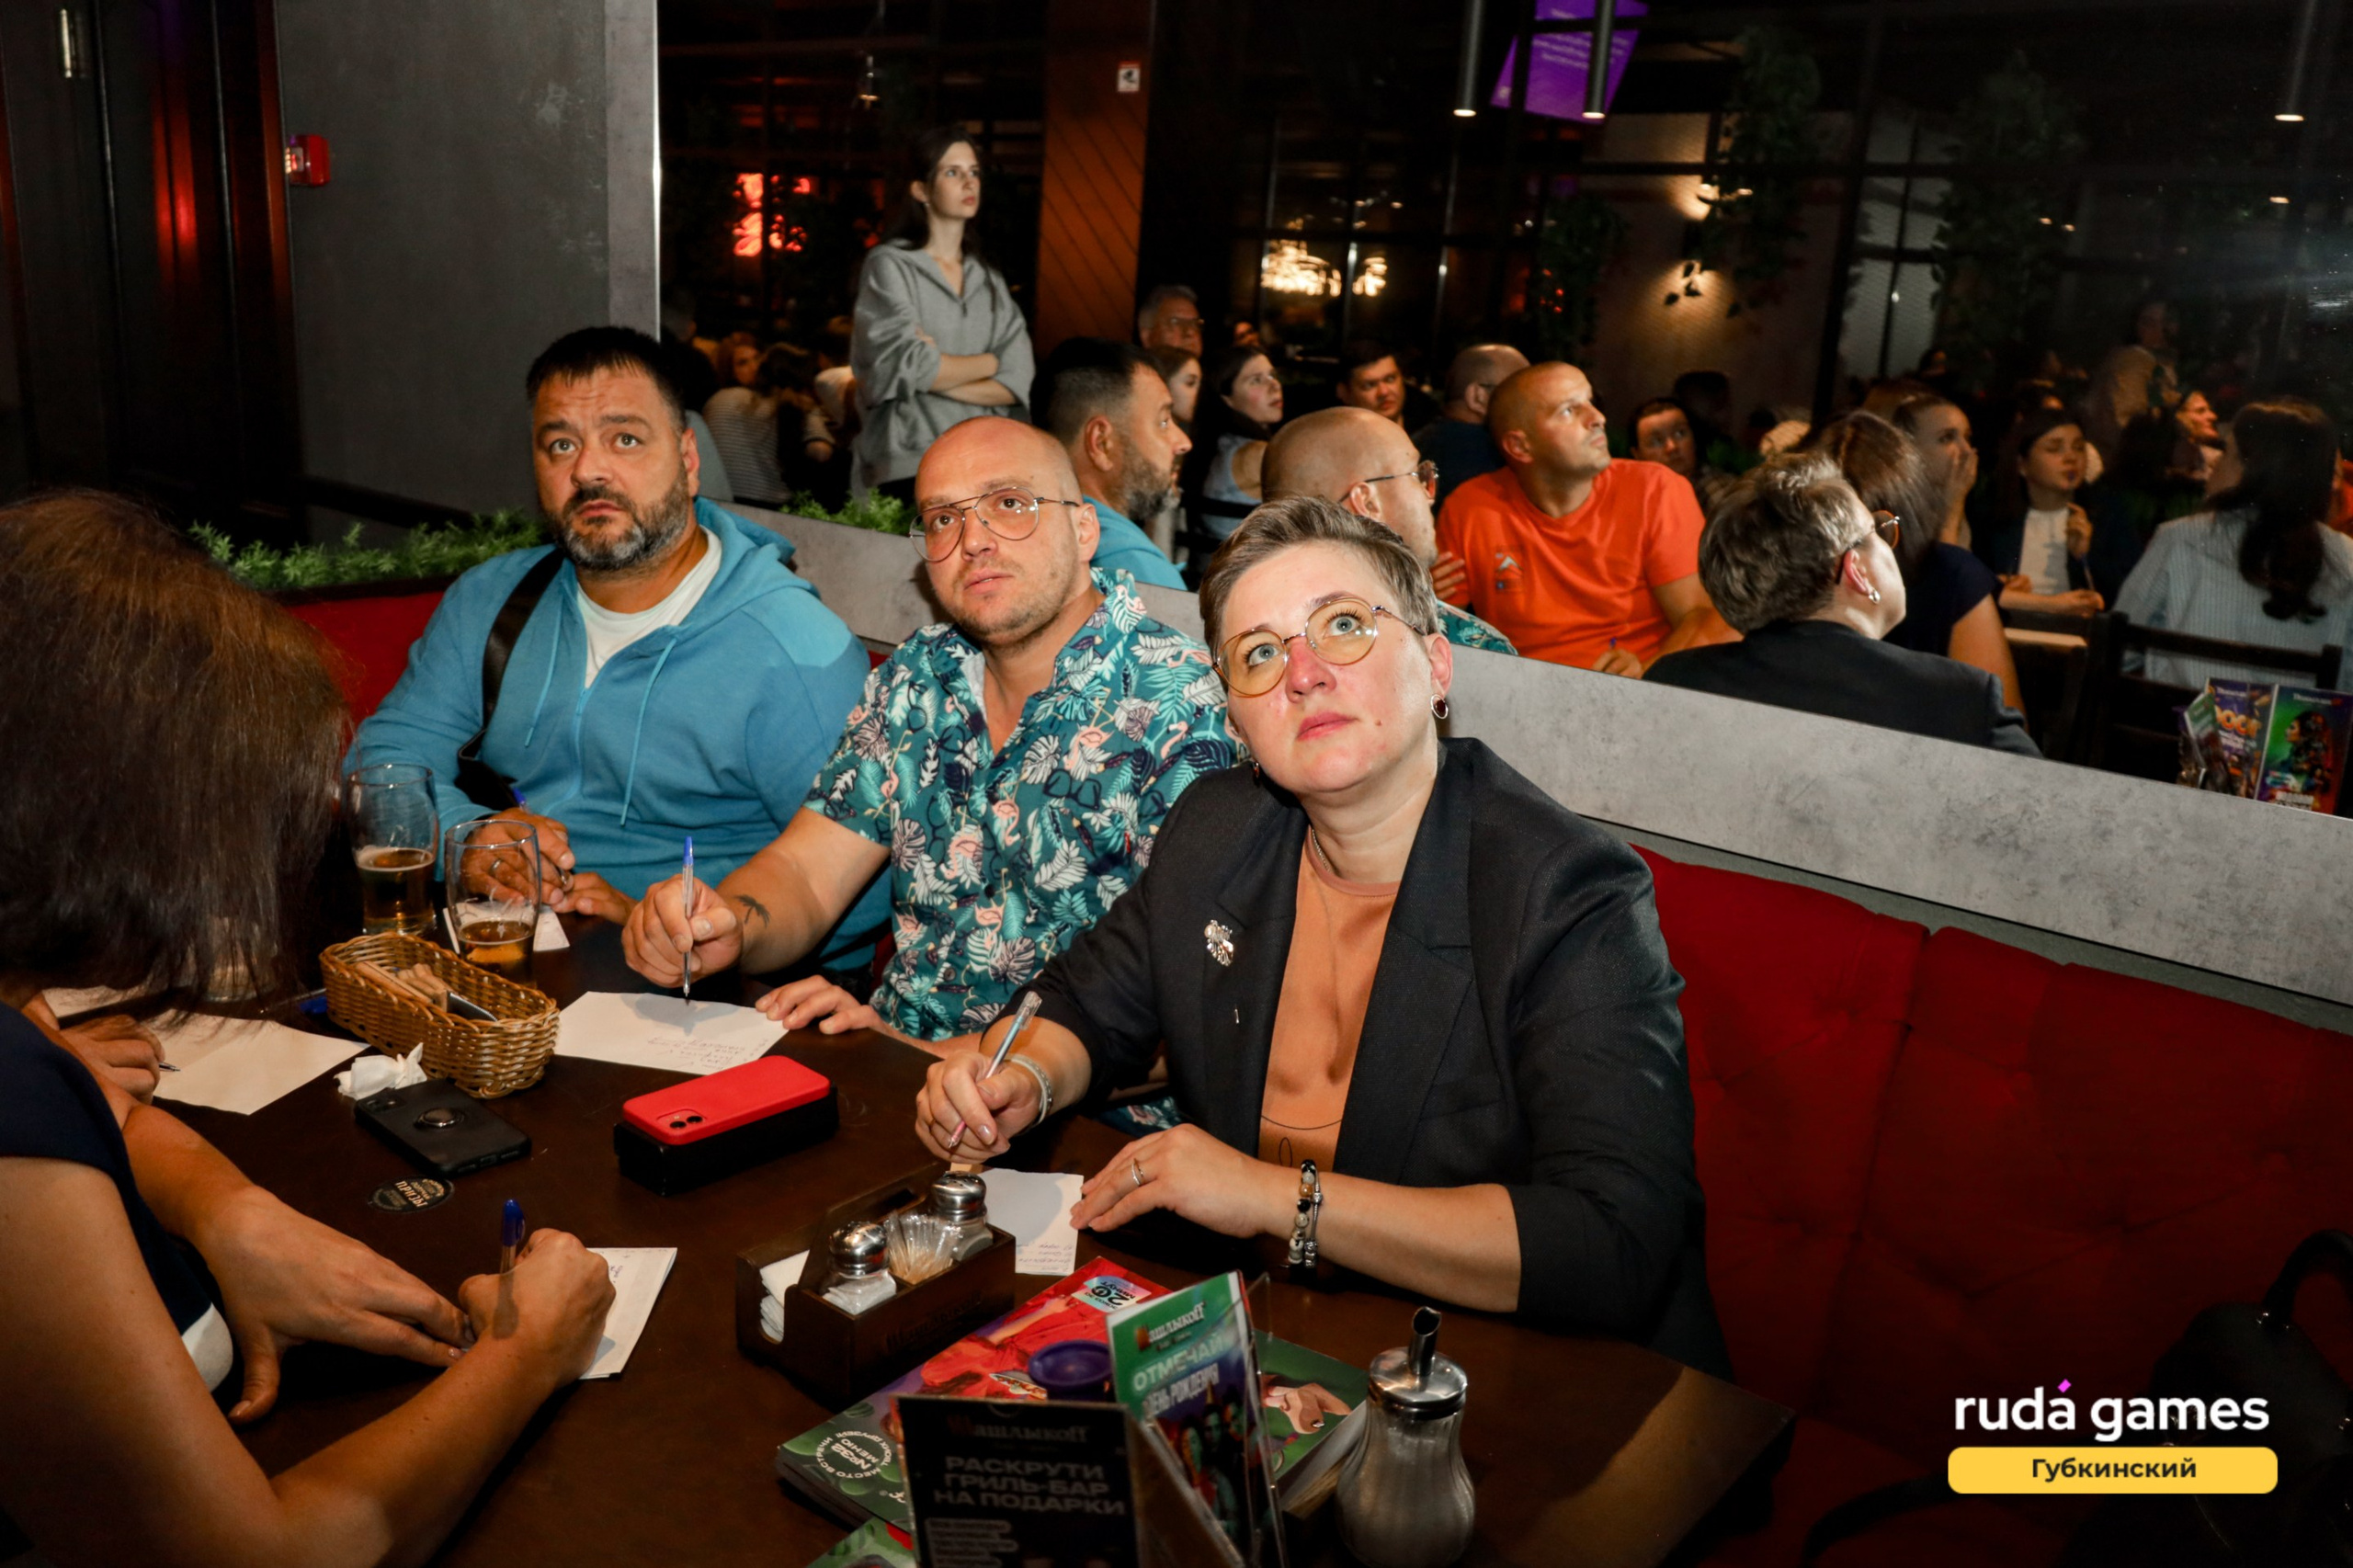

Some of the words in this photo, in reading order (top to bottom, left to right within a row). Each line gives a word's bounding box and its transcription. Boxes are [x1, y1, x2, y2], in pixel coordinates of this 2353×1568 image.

[1092, 1286, 1130, 1306] 20
[1100, 1281, 1136, 1300] МИНУТ
[1132, 1331, 1225, 1392] ОТМЕЧАЙ
[815, 1437, 835, 1473] ВСТРЕЧИ
[831, 1442, 872, 1470] №32
[840, 1437, 880, 1464] МЕНЮ
[835, 1467, 881, 1479] МЕСТО
[943, 1454, 1106, 1481] РАСКРУТИ
[942, 1471, 1111, 1497] ГРИЛЬ-БАР
[932, 1487, 977, 1506] НА
[978, 1490, 1127, 1516] ПОДАРКИ
